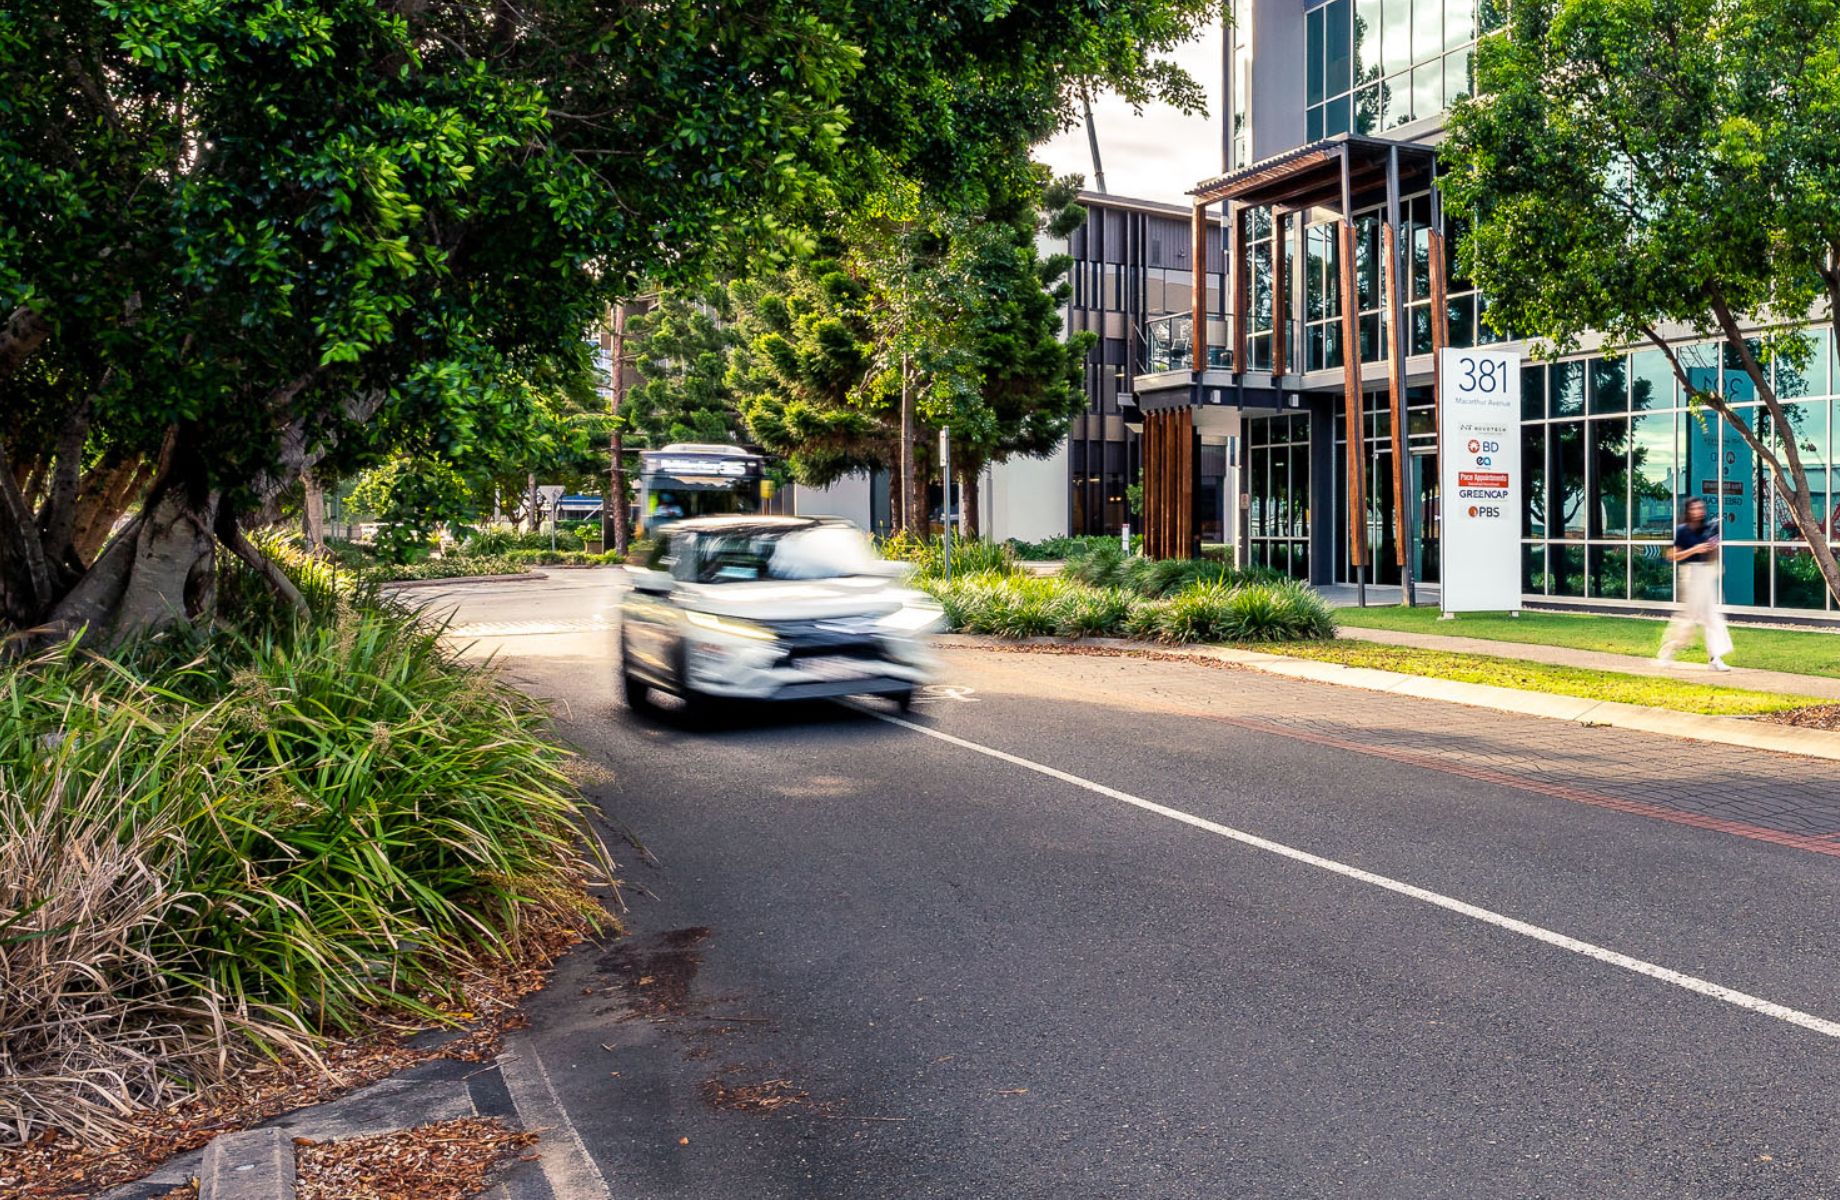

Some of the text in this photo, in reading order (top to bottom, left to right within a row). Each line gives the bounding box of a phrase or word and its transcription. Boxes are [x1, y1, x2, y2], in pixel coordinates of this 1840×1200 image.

[1459, 357, 1507, 393] 381
[1488, 399, 1511, 407] Avenue
[1483, 441, 1499, 453] BD
[1459, 489, 1508, 499] GREENCAP
[1479, 506, 1500, 518] PBS
